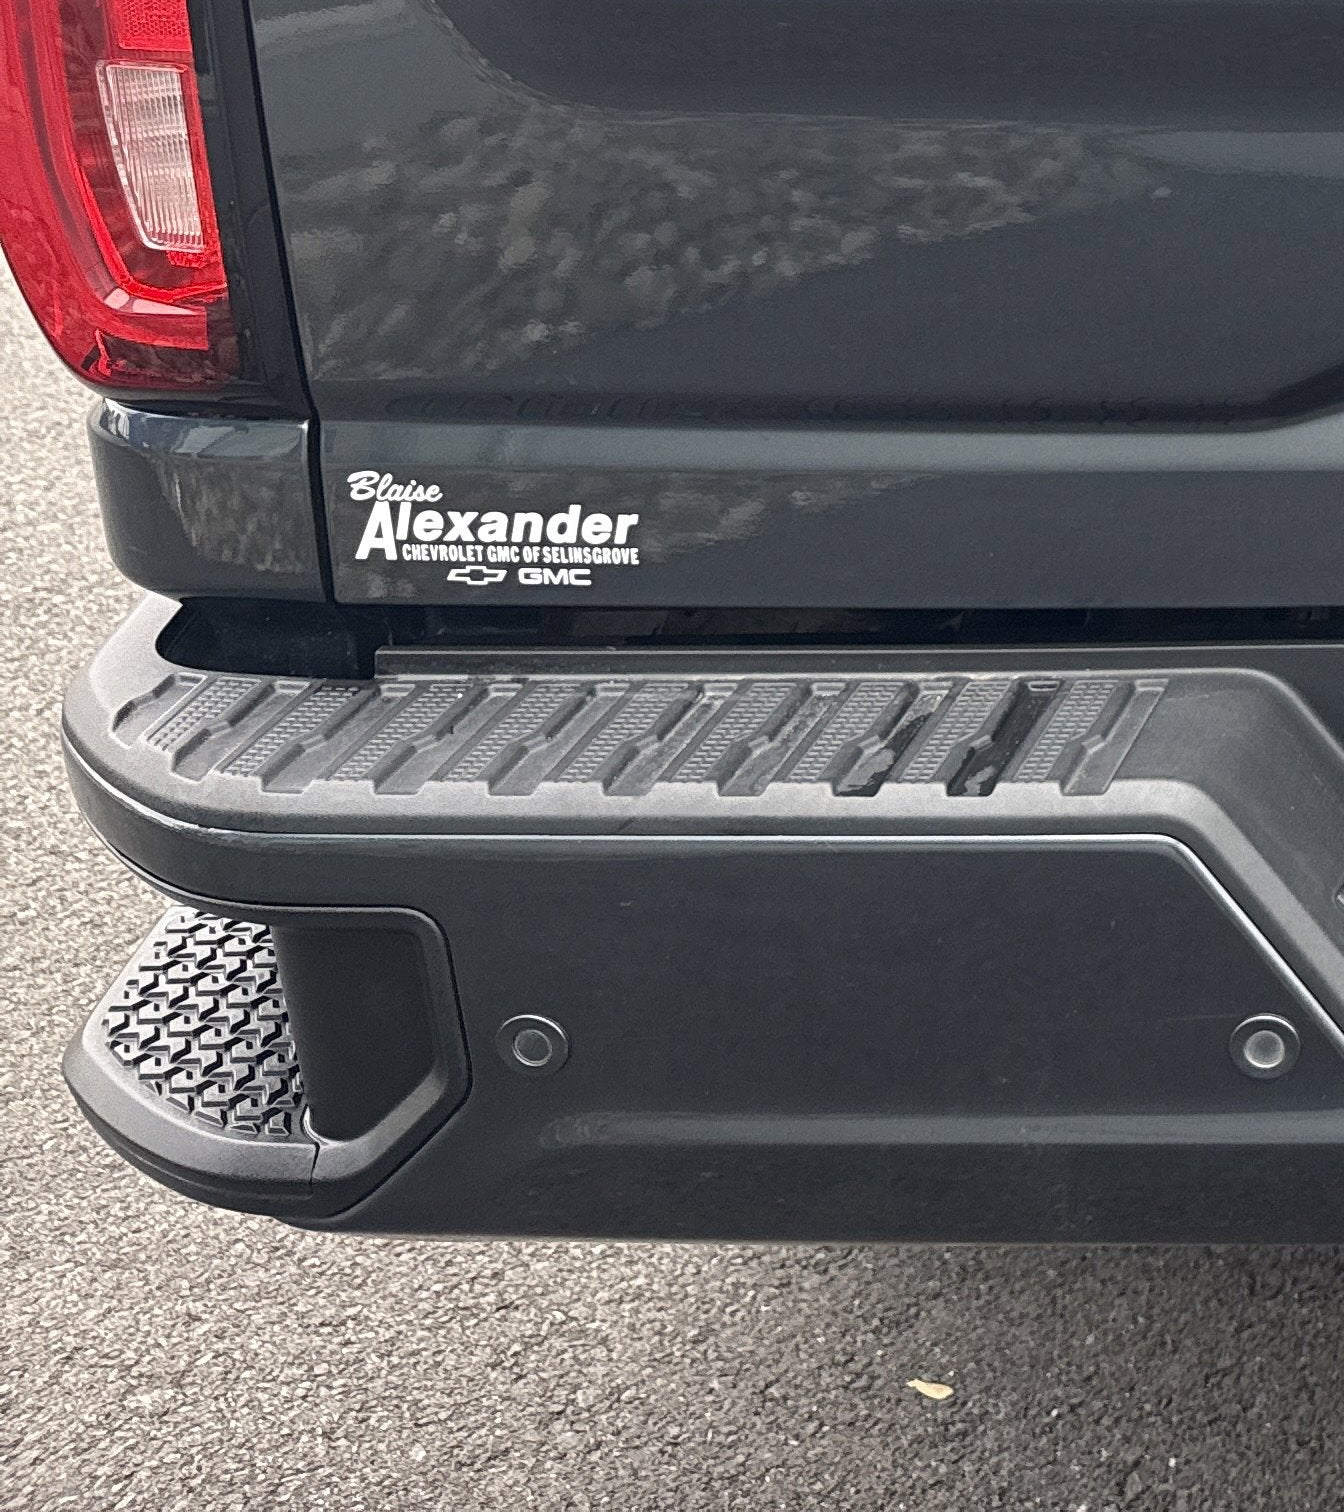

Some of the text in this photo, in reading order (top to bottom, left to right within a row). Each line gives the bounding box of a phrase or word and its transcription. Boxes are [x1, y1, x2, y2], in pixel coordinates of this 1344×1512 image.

[347, 470, 443, 502] Blaise
[355, 500, 639, 561] Alexander
[402, 543, 640, 565] CHEVROLET GMC OF SELINSGROVE
[518, 568, 593, 586] GMC
